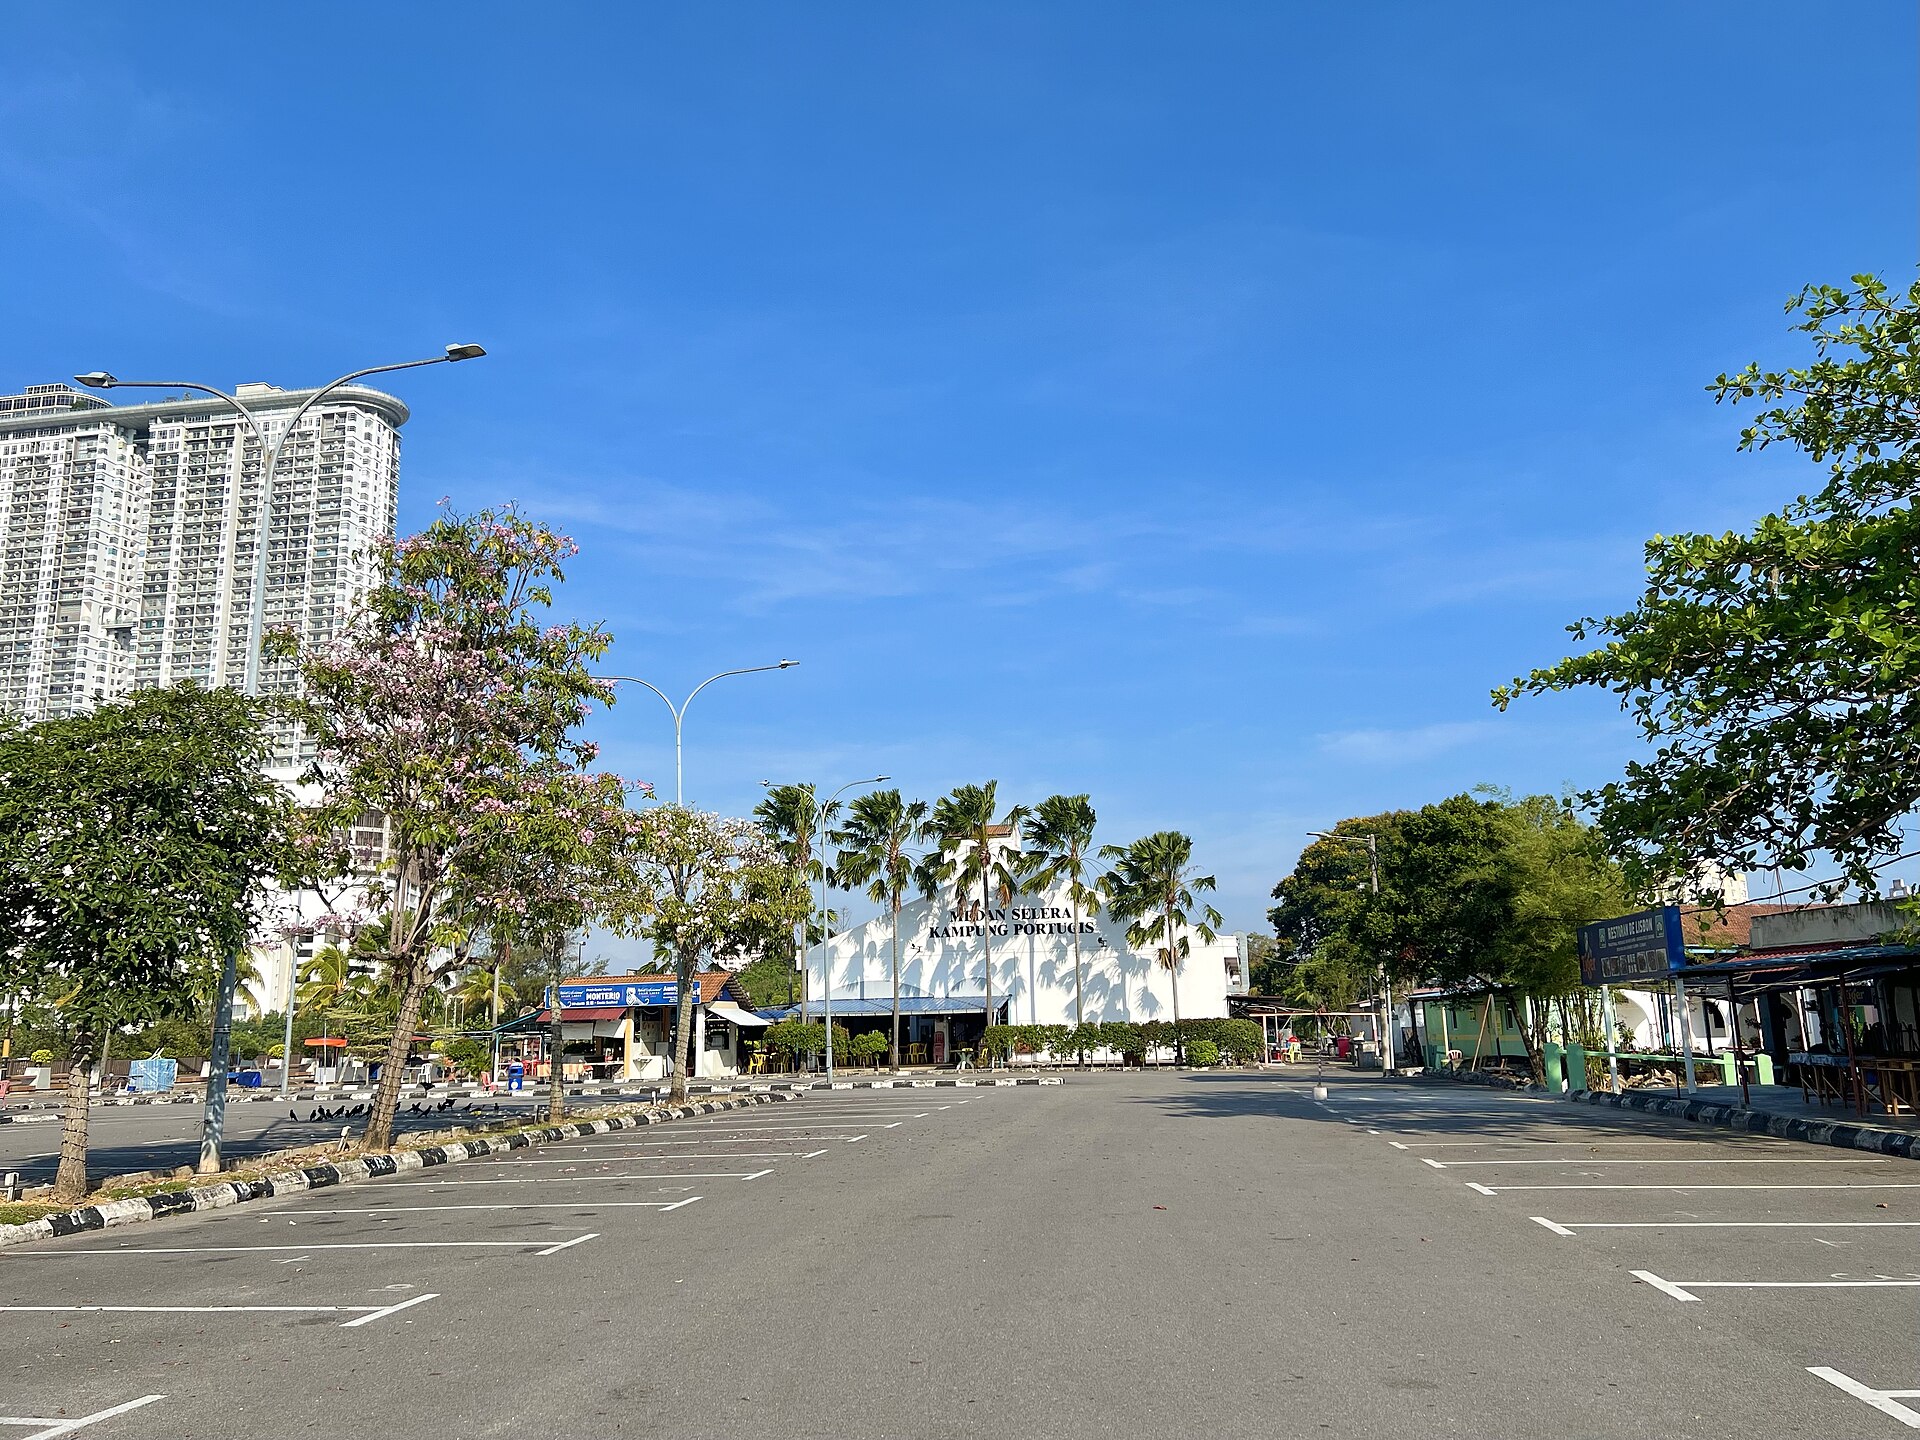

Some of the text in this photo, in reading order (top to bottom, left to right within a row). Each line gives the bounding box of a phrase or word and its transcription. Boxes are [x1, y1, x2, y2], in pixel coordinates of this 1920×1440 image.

[1011, 907, 1072, 920] SELERA
[929, 922, 1095, 938] KAMPUNG PORTUGIS
[1607, 923, 1629, 940] RESTORAN
[1629, 921, 1635, 935] DE
[1635, 918, 1653, 933] LISBON
